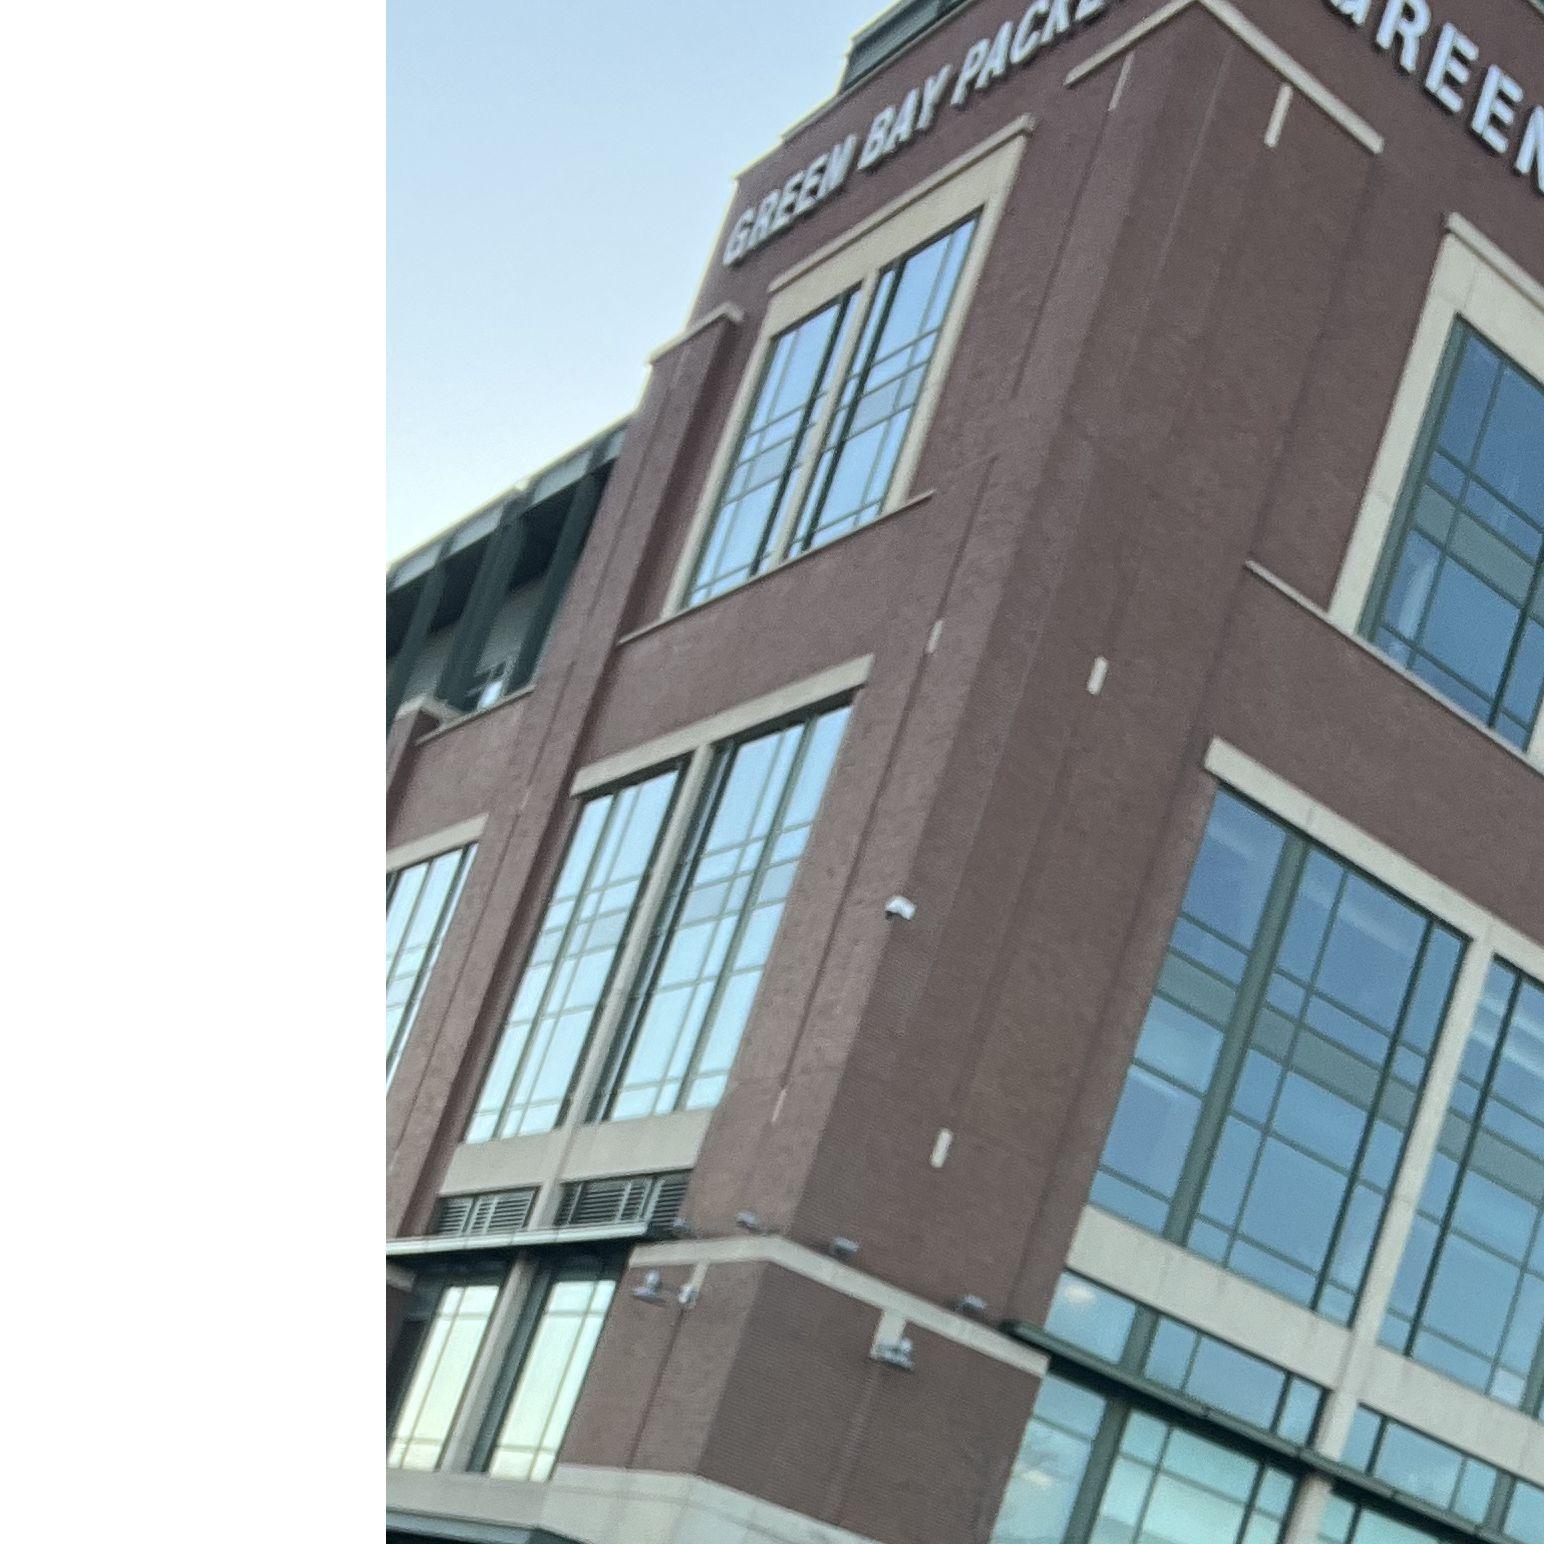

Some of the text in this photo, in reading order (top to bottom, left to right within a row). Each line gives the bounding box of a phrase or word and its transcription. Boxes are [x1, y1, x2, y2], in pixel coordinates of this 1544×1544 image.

[723, 0, 1105, 268] GREEN BAY PACK
